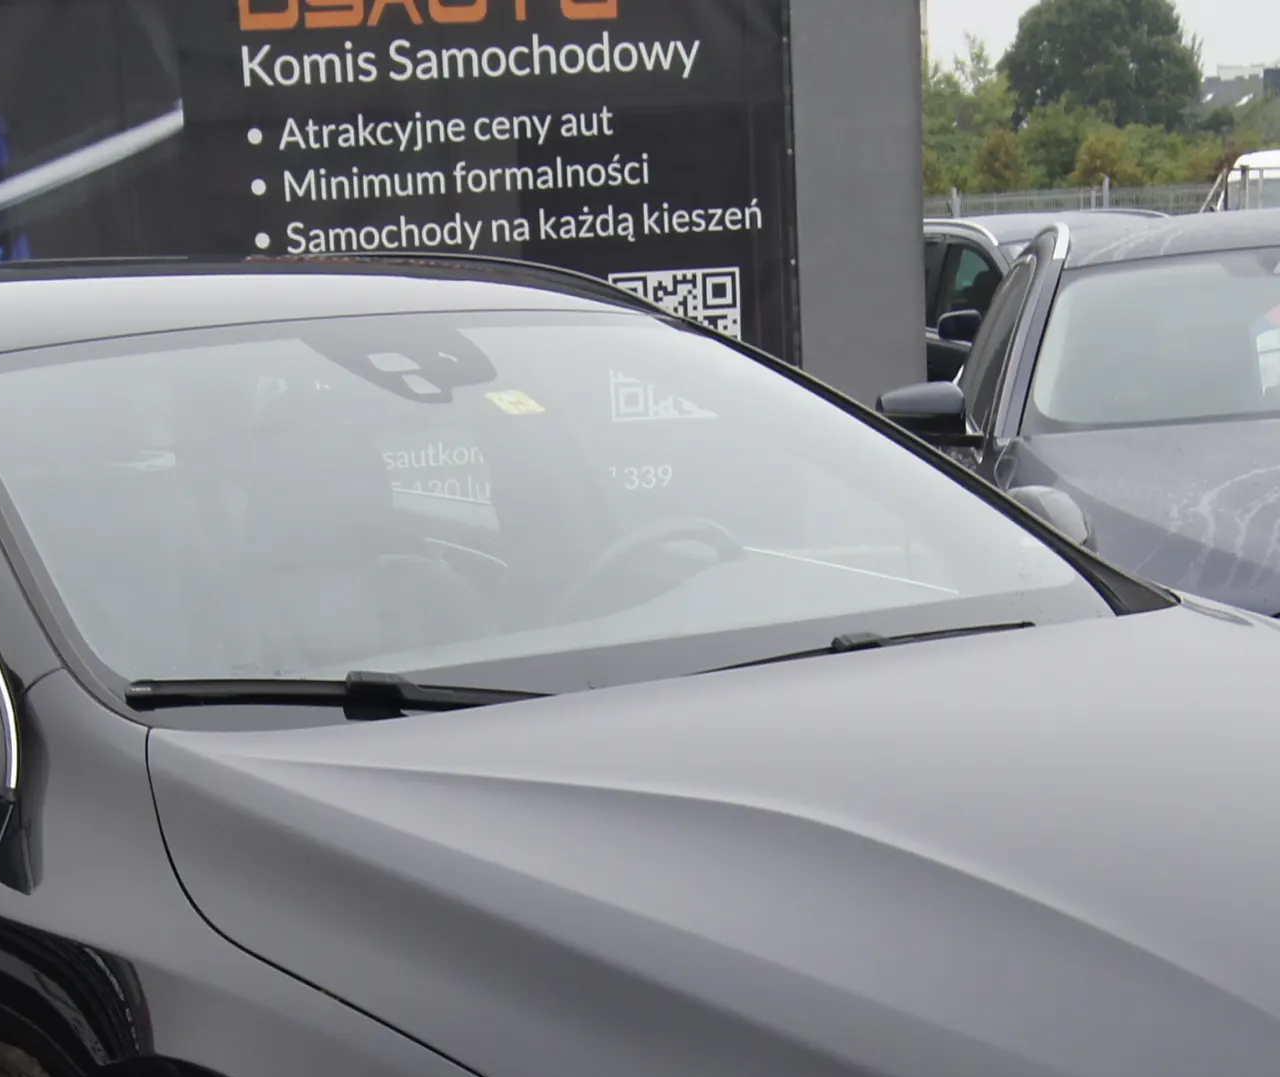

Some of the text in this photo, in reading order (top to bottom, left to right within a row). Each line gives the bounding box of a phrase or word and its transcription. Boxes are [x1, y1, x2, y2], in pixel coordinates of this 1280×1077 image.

[240, 31, 700, 87] Komis Samochodowy
[278, 106, 613, 152] Atrakcyjne ceny aut
[283, 153, 649, 202] Minimum formalności
[286, 198, 762, 254] Samochody na każdą kieszeń
